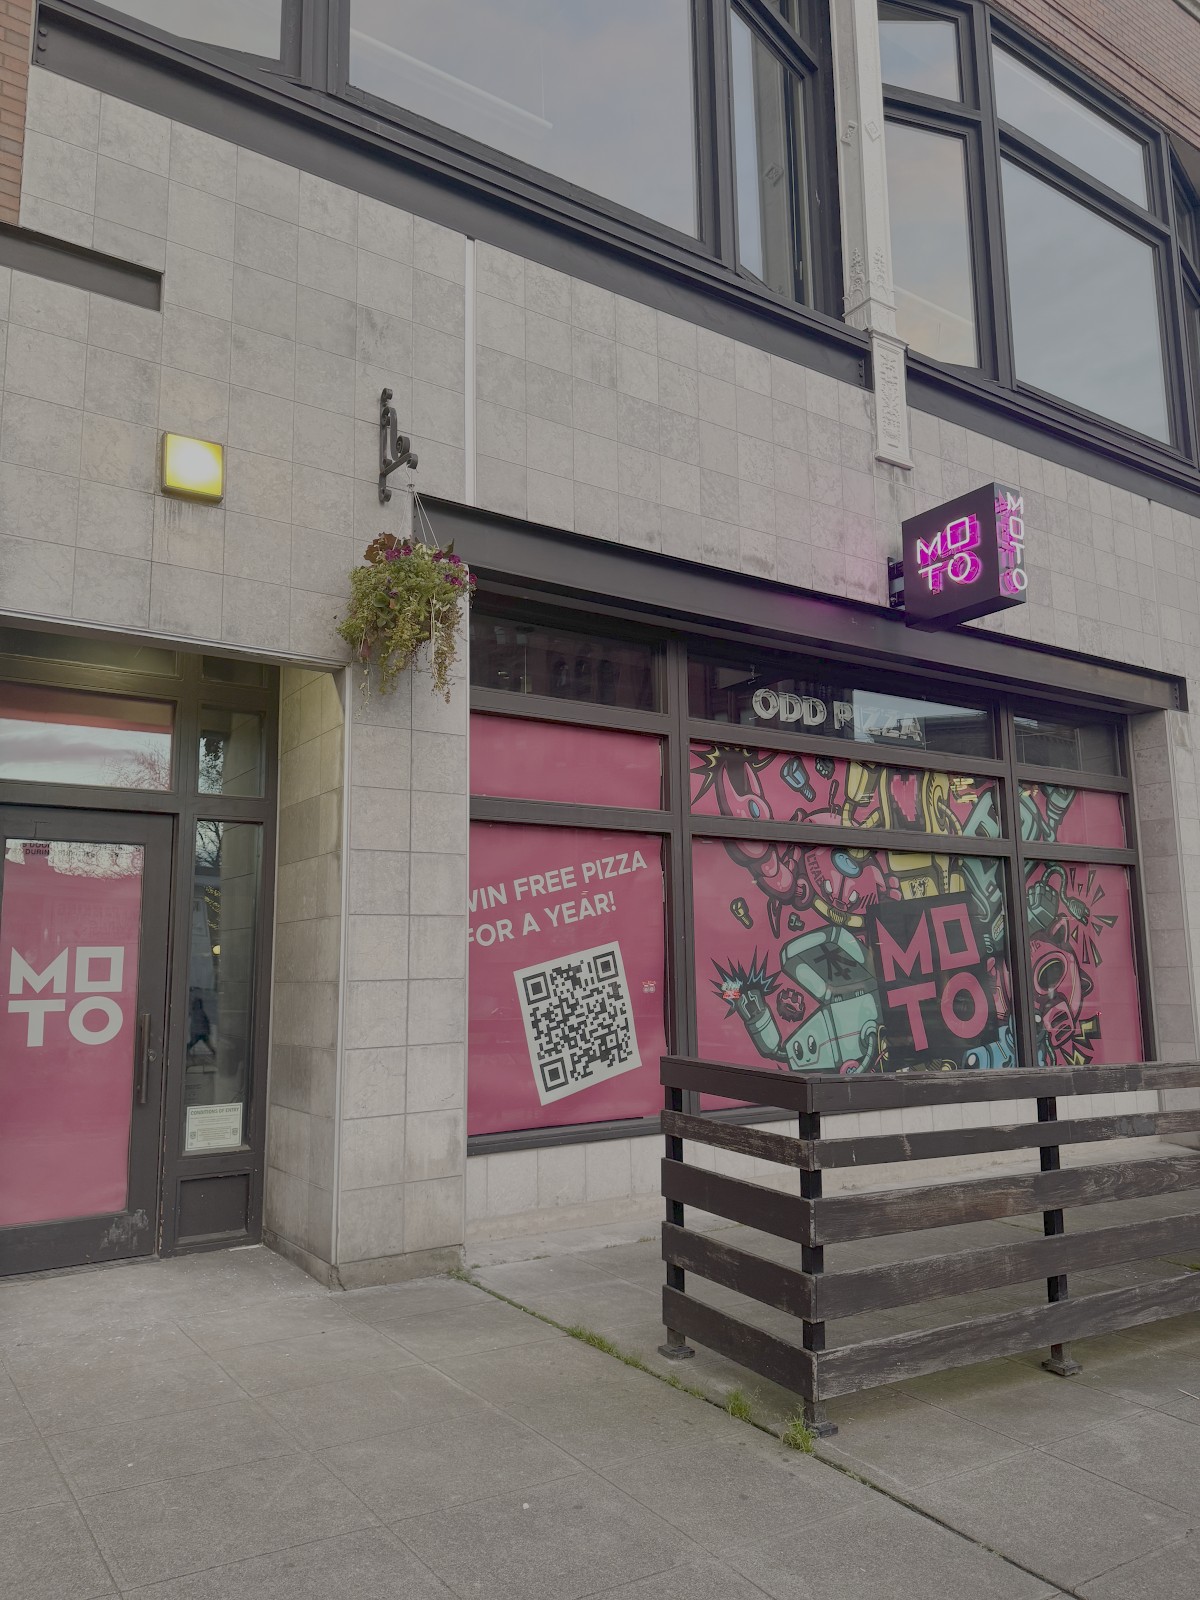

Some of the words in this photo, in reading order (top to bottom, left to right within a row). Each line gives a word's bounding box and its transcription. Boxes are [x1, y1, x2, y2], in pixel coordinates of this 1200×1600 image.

[752, 688, 827, 726] ODD
[513, 866, 577, 900] FREE
[581, 851, 648, 883] PIZZA
[522, 912, 541, 936] A
[544, 891, 617, 928] YEAR!
[875, 902, 981, 982] MO
[8, 946, 125, 995] MO
[8, 996, 125, 1048] TO
[887, 972, 989, 1052] TO
